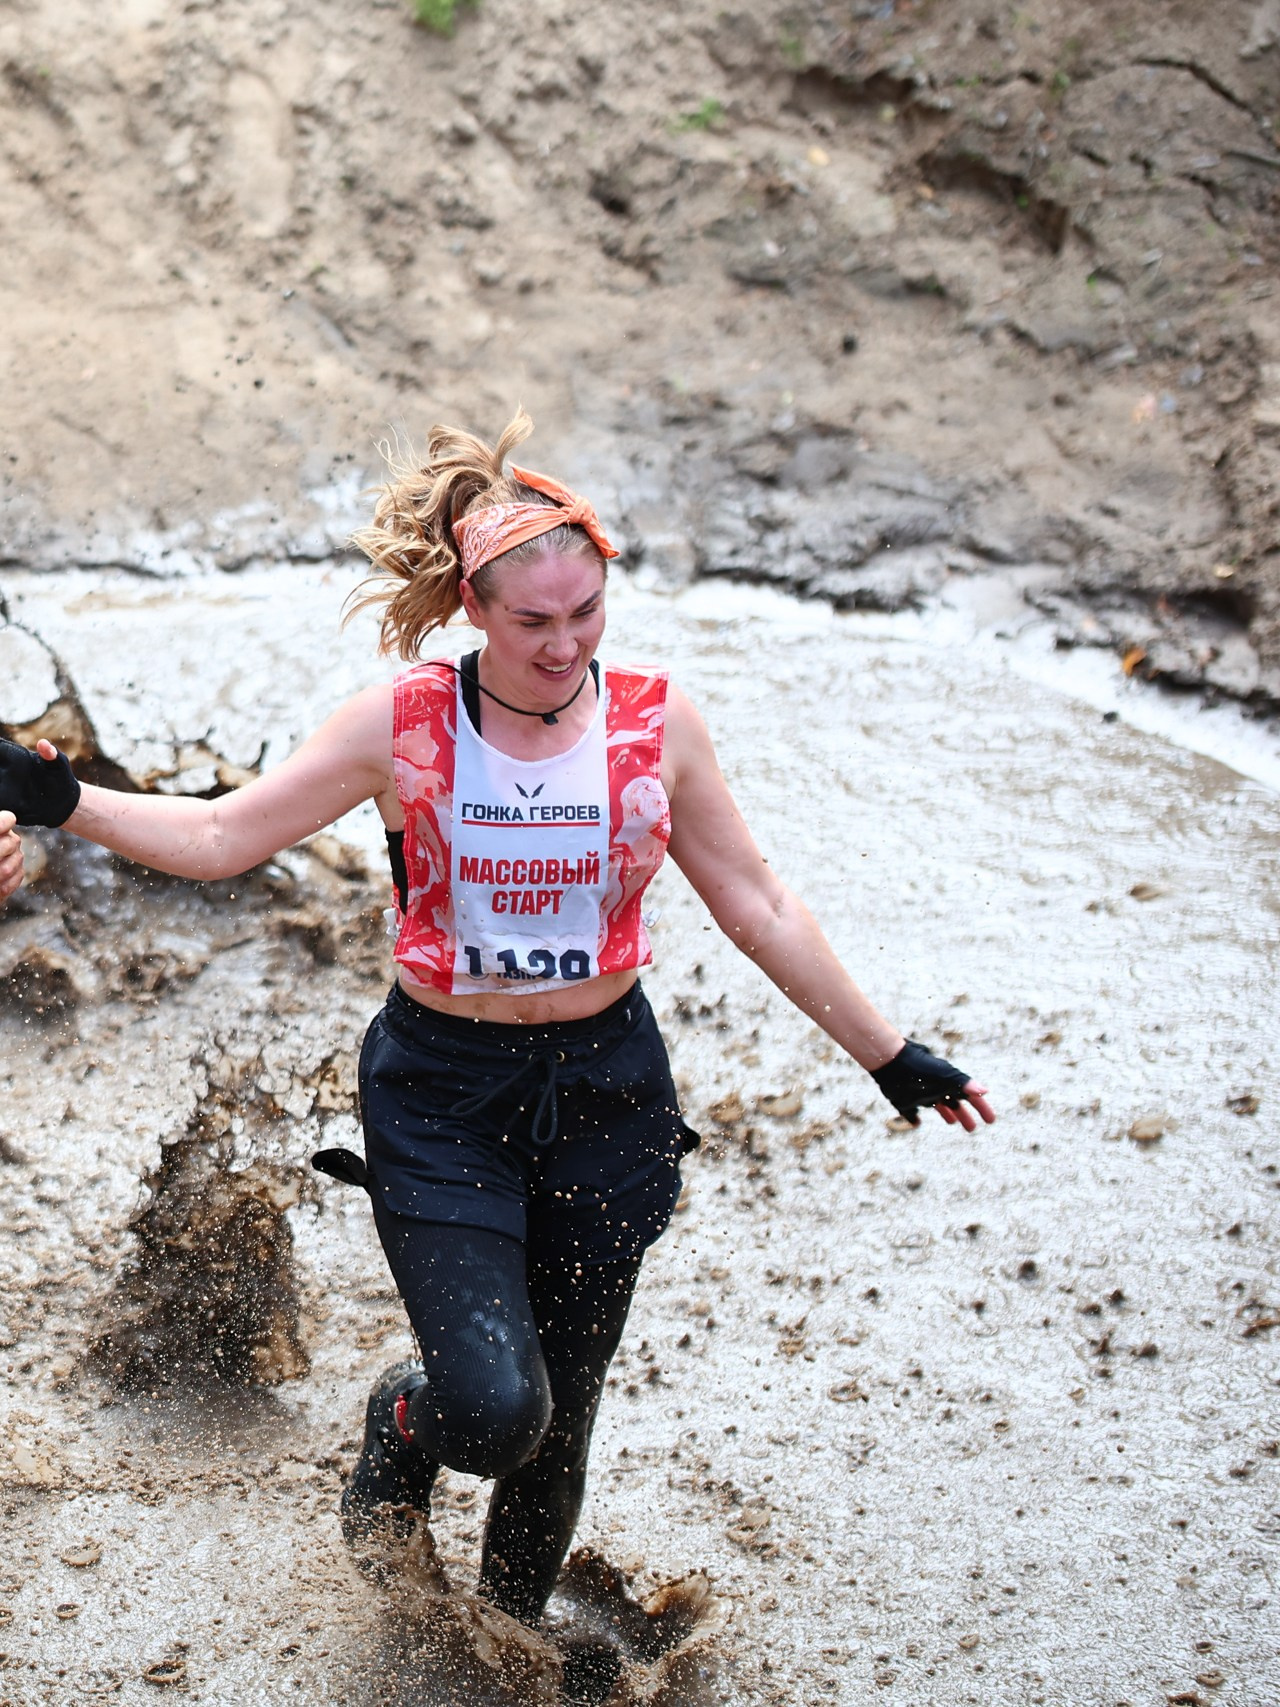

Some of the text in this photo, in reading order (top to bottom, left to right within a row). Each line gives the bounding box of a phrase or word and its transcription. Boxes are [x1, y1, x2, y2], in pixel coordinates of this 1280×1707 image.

[461, 802, 601, 821] ГОНКА ГЕРОЕВ
[459, 851, 601, 885] МАССОВЫЙ
[491, 890, 564, 915] СТАРТ
